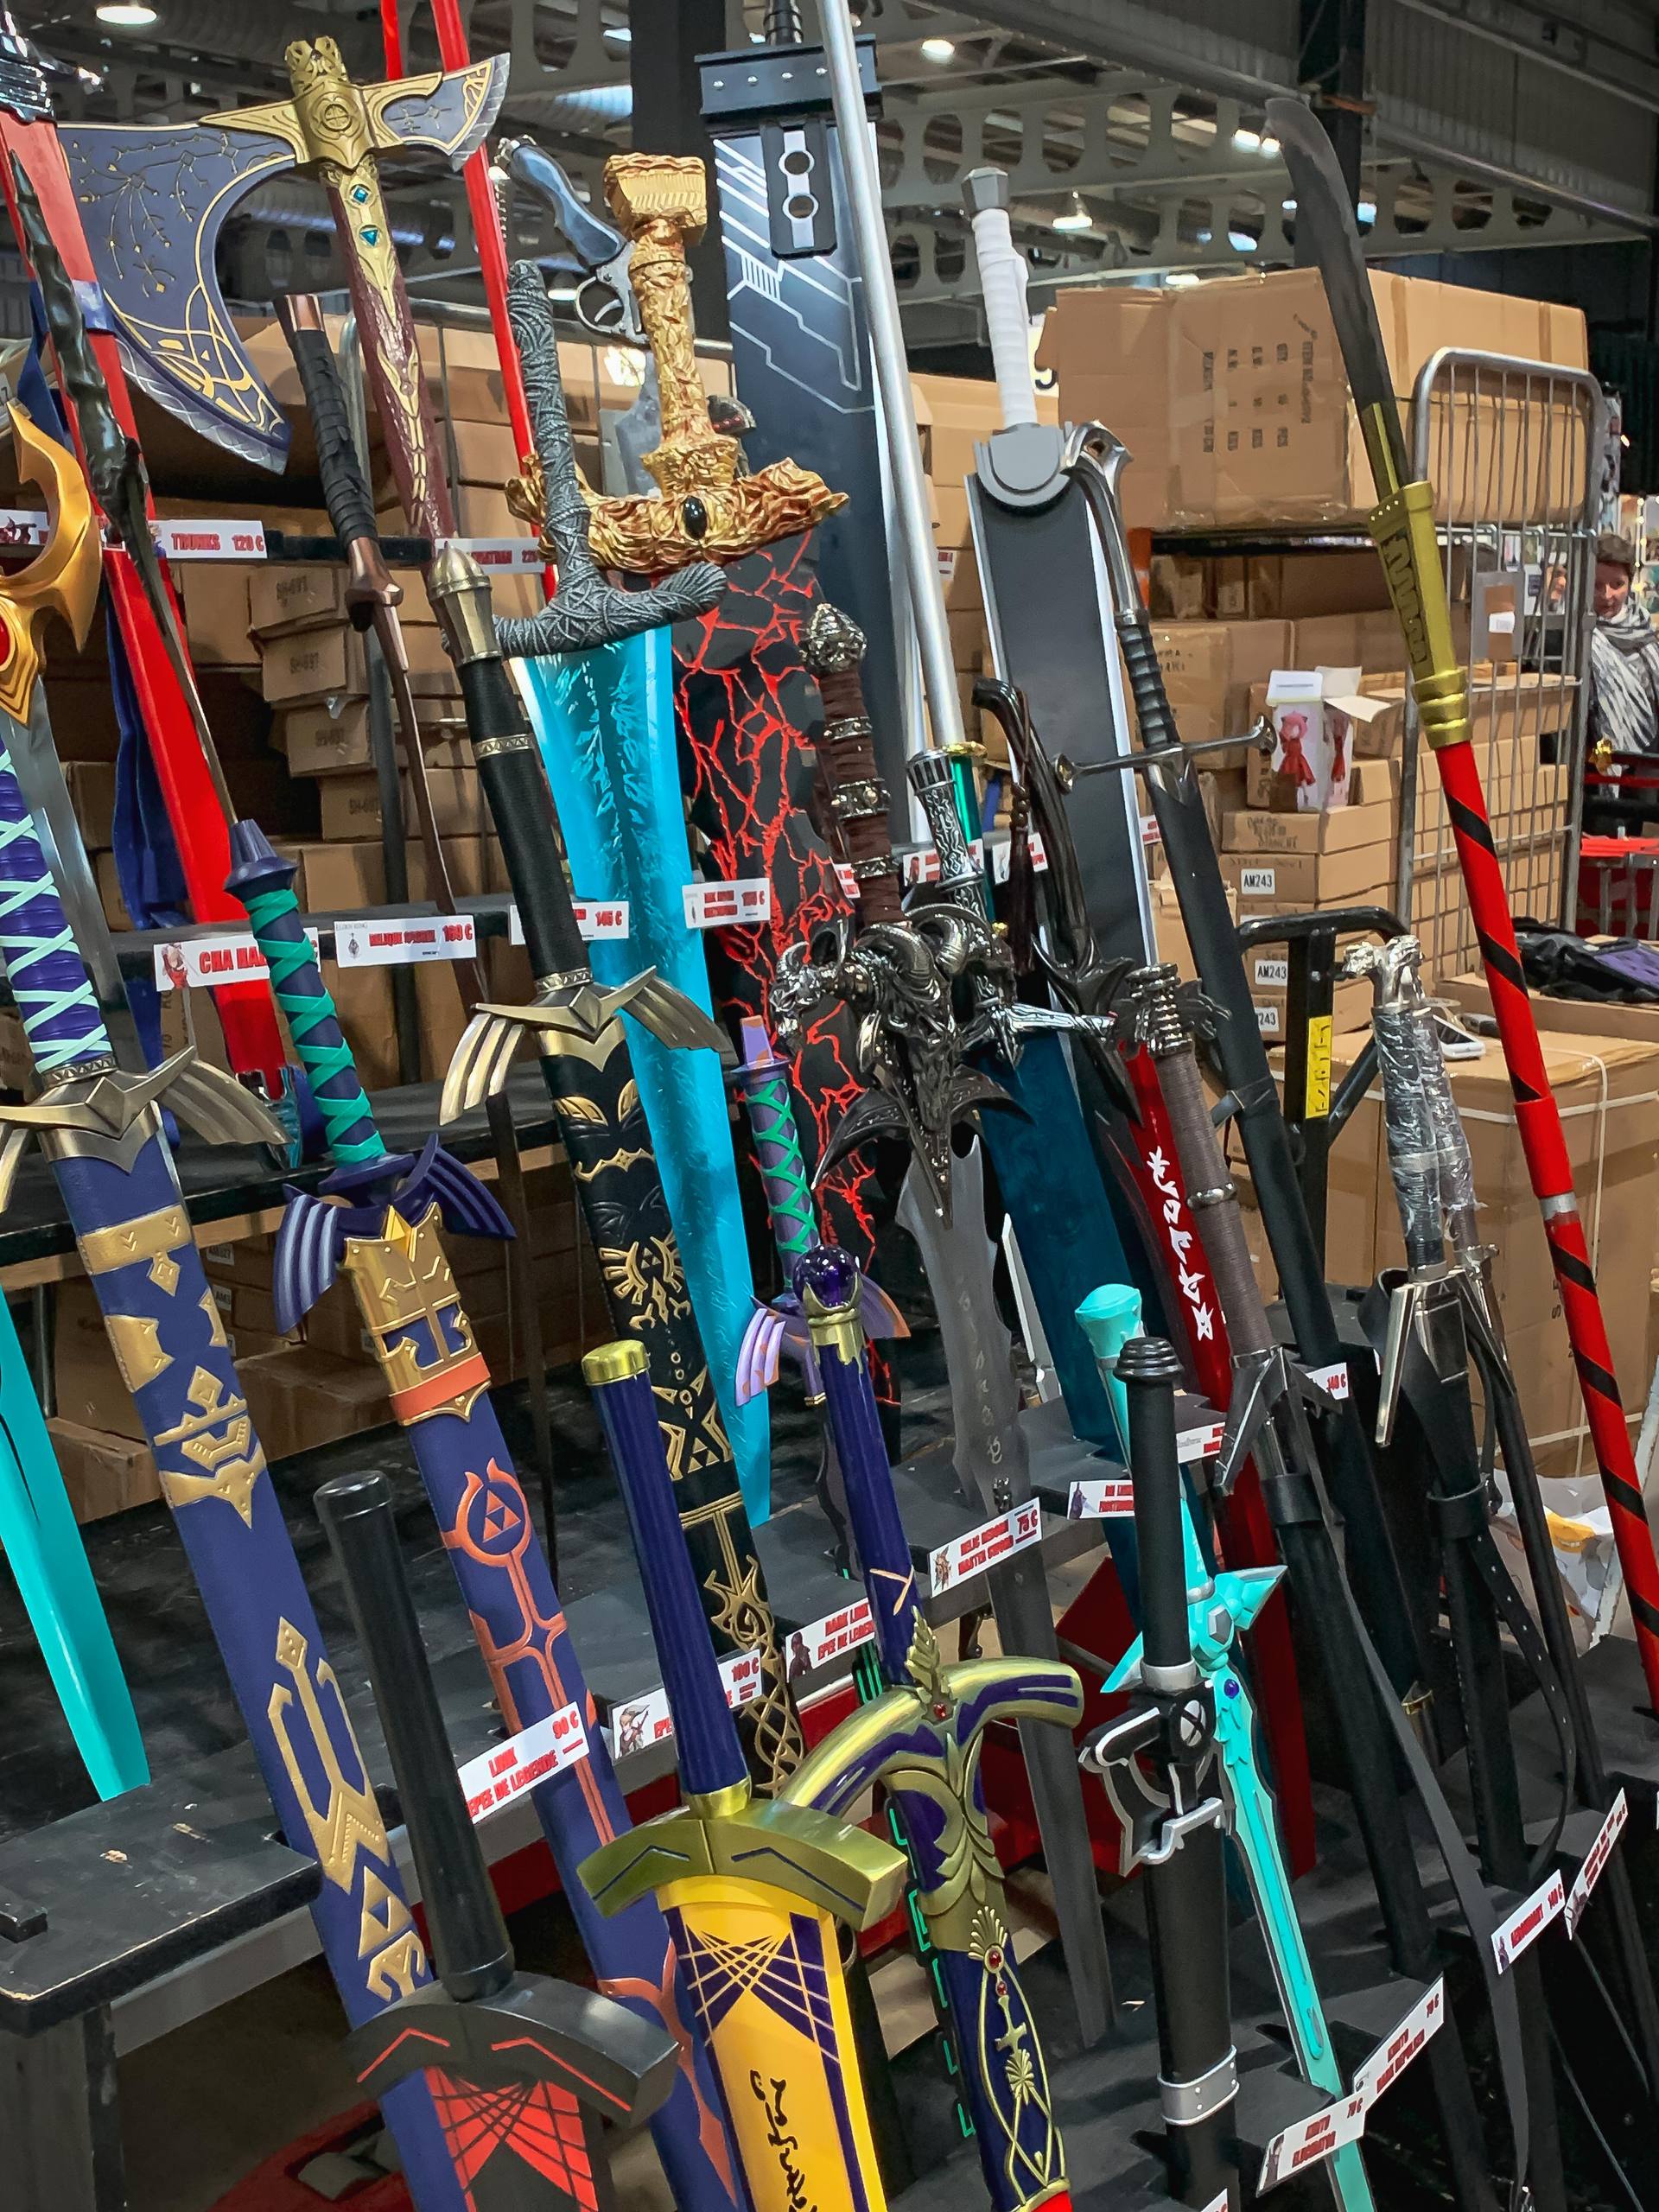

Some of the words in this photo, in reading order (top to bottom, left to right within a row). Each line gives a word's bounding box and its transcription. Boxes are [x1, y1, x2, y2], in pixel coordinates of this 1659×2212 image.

[171, 532, 221, 551] TRUNKS
[1243, 874, 1273, 888] AM243
[1257, 964, 1287, 980] AM243
[1258, 1011, 1276, 1027] 243
[488, 1745, 518, 1778] LINK
[493, 1777, 511, 1802] DE
